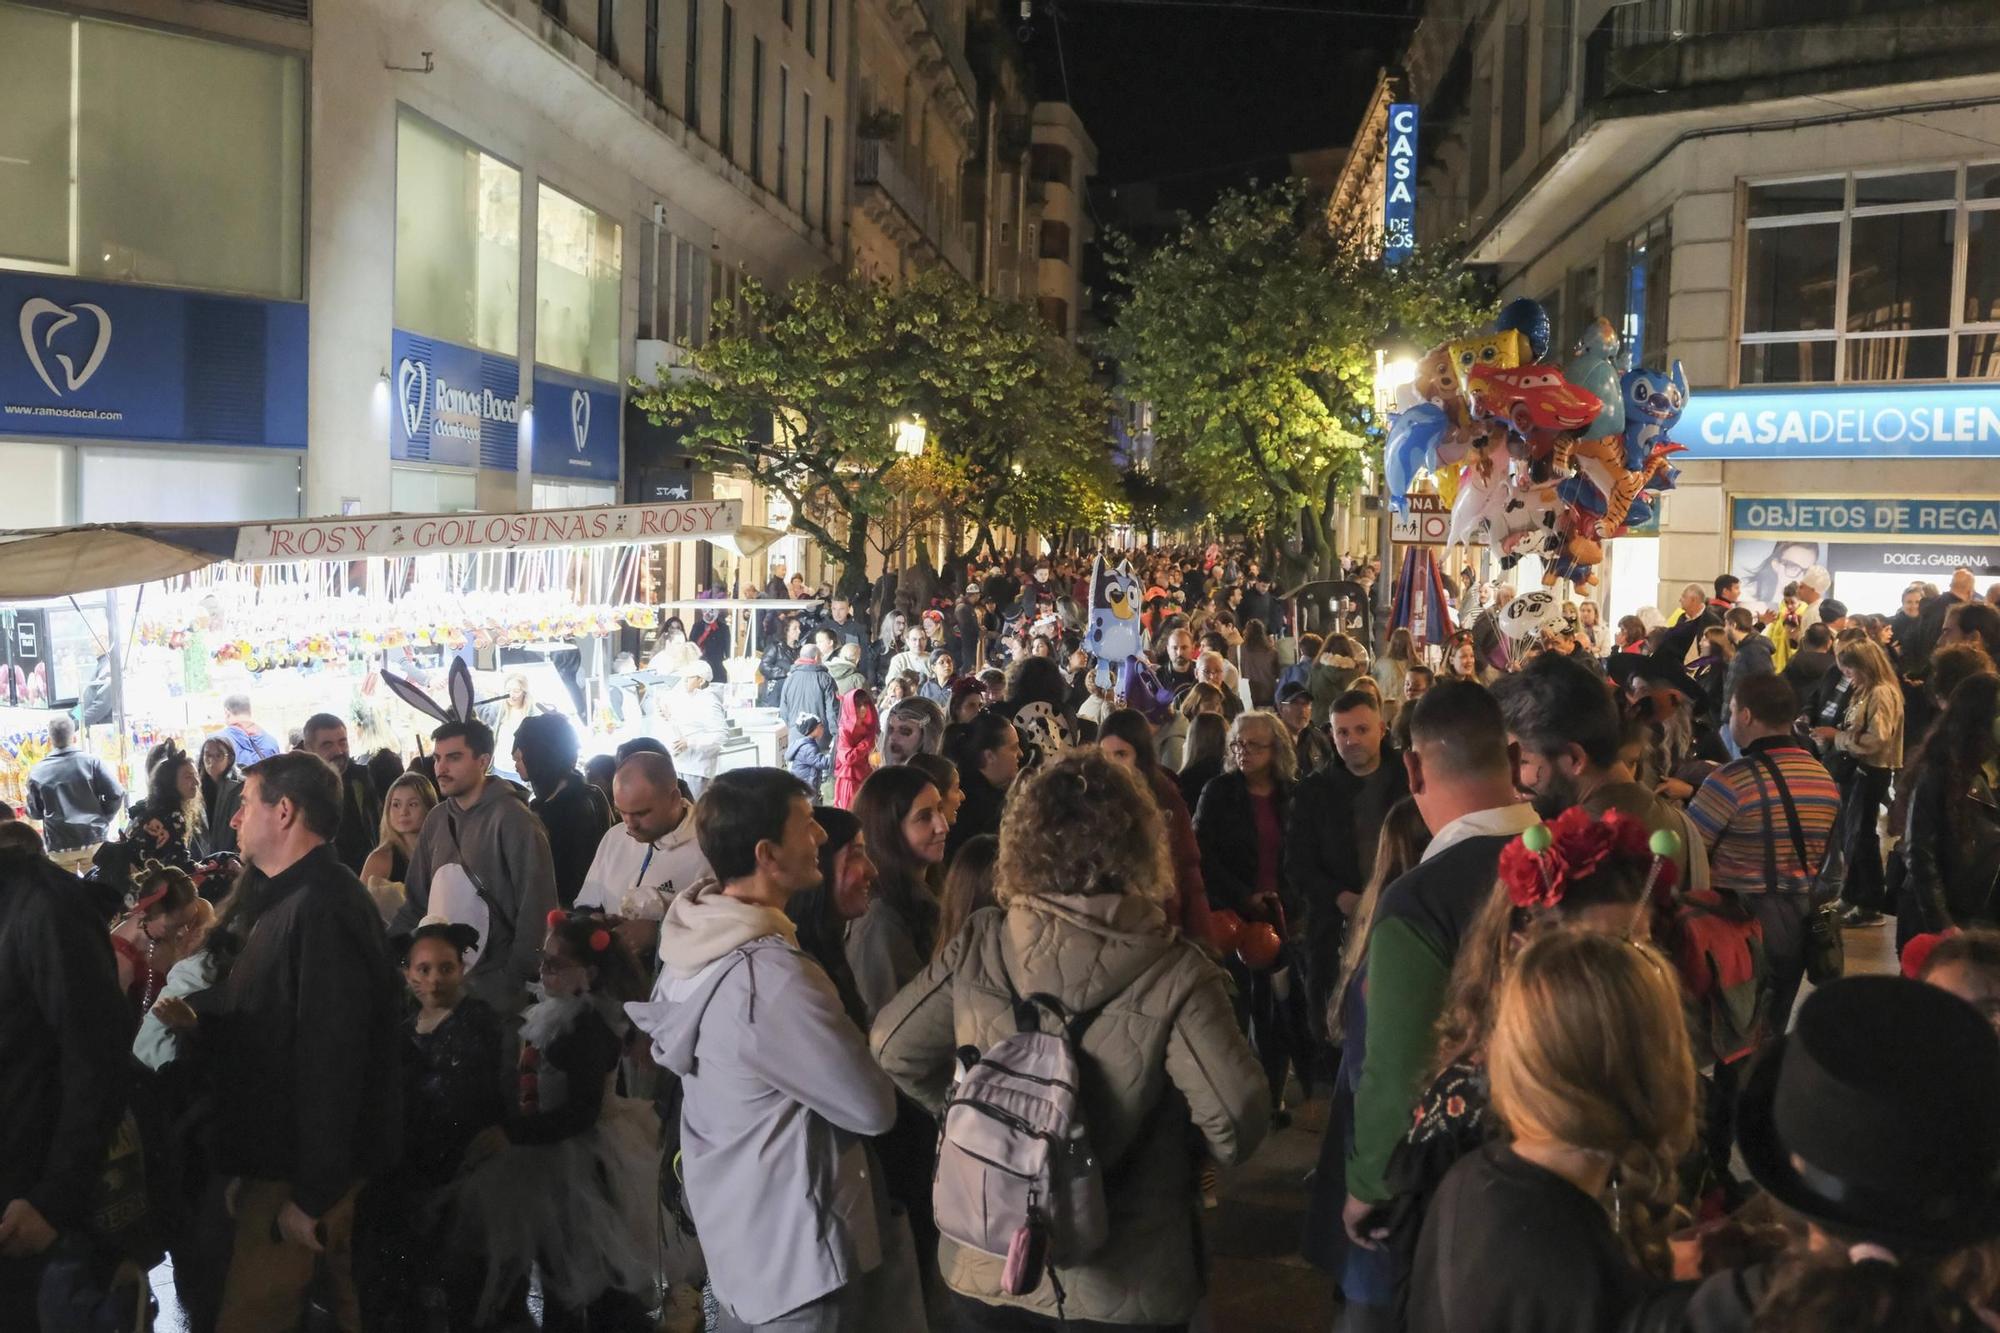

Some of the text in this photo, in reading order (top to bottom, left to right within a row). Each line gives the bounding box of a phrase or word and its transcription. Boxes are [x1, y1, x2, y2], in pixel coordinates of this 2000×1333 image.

[1390, 111, 1413, 203] CASA
[1390, 218, 1409, 232] DE
[4, 405, 122, 420] www.ramosdacal.com
[435, 378, 480, 416] Ramos
[269, 506, 721, 556] ROSY GOLOSINAS ROSY
[1747, 505, 1998, 530] OBJETOS DE REGA
